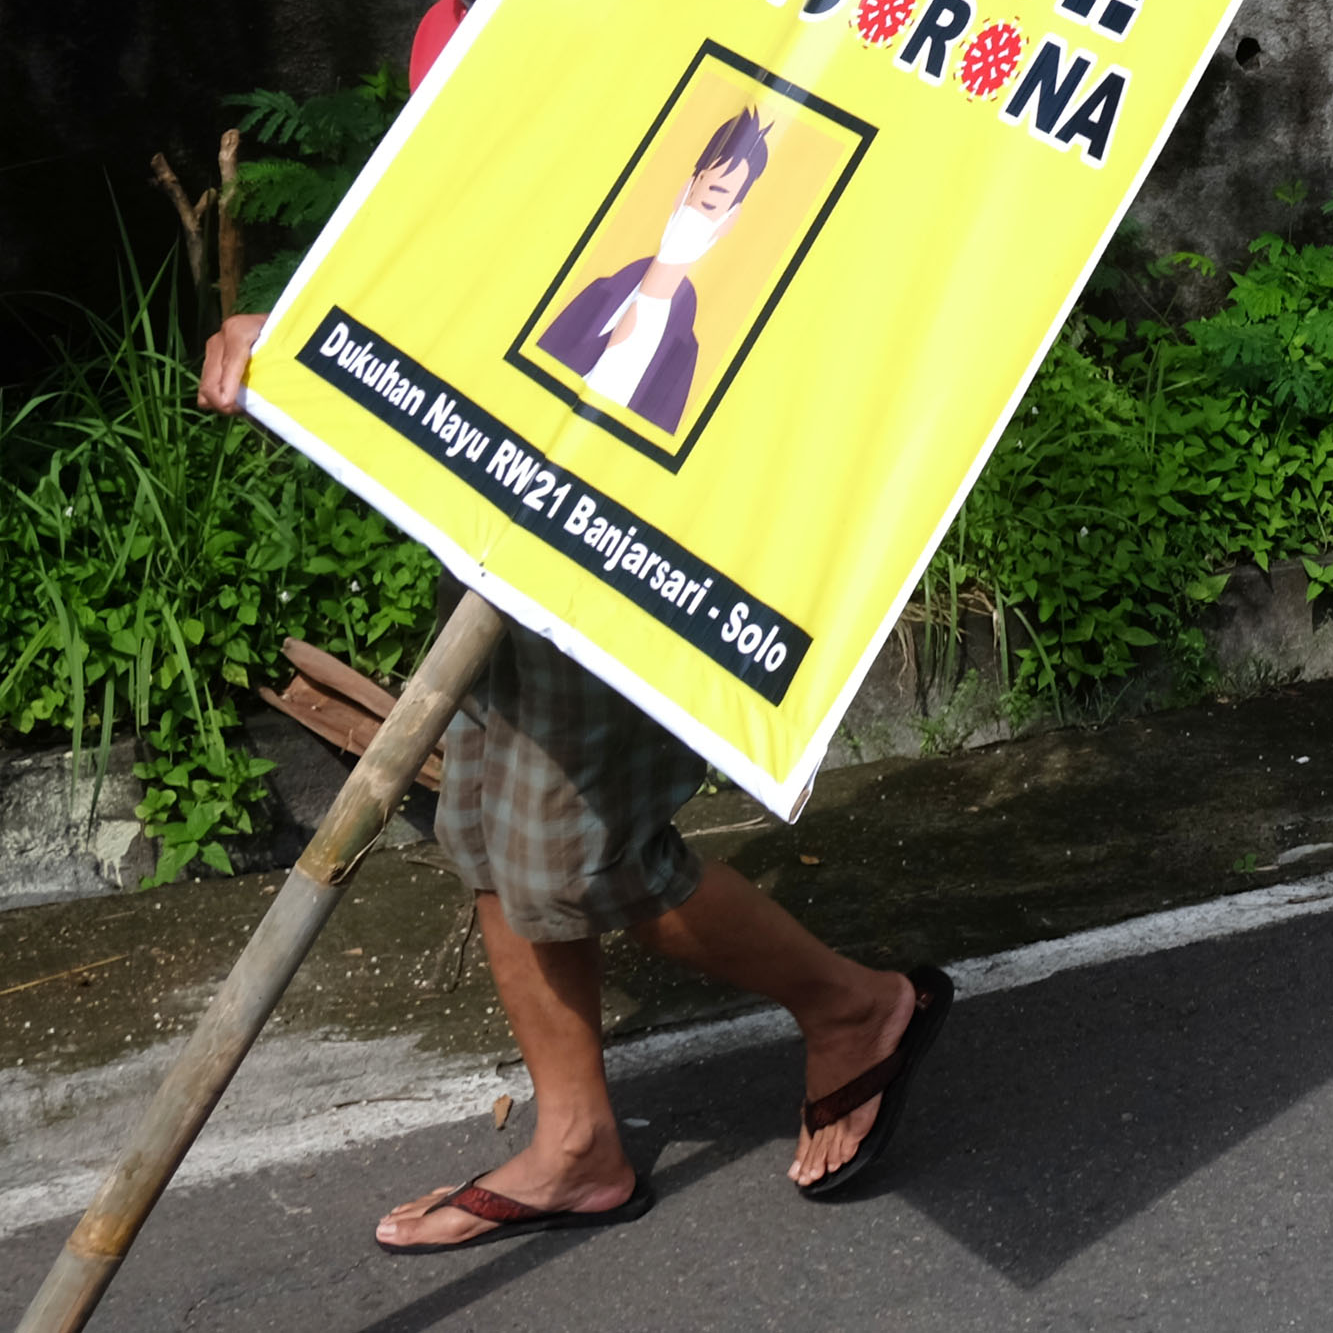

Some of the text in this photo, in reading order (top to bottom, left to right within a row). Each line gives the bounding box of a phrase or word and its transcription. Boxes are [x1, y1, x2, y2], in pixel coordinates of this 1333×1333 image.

[319, 322, 425, 416] Dukuhan
[422, 392, 490, 462] Nayu
[564, 496, 713, 615] Banjarsari
[720, 602, 788, 673] Solo
